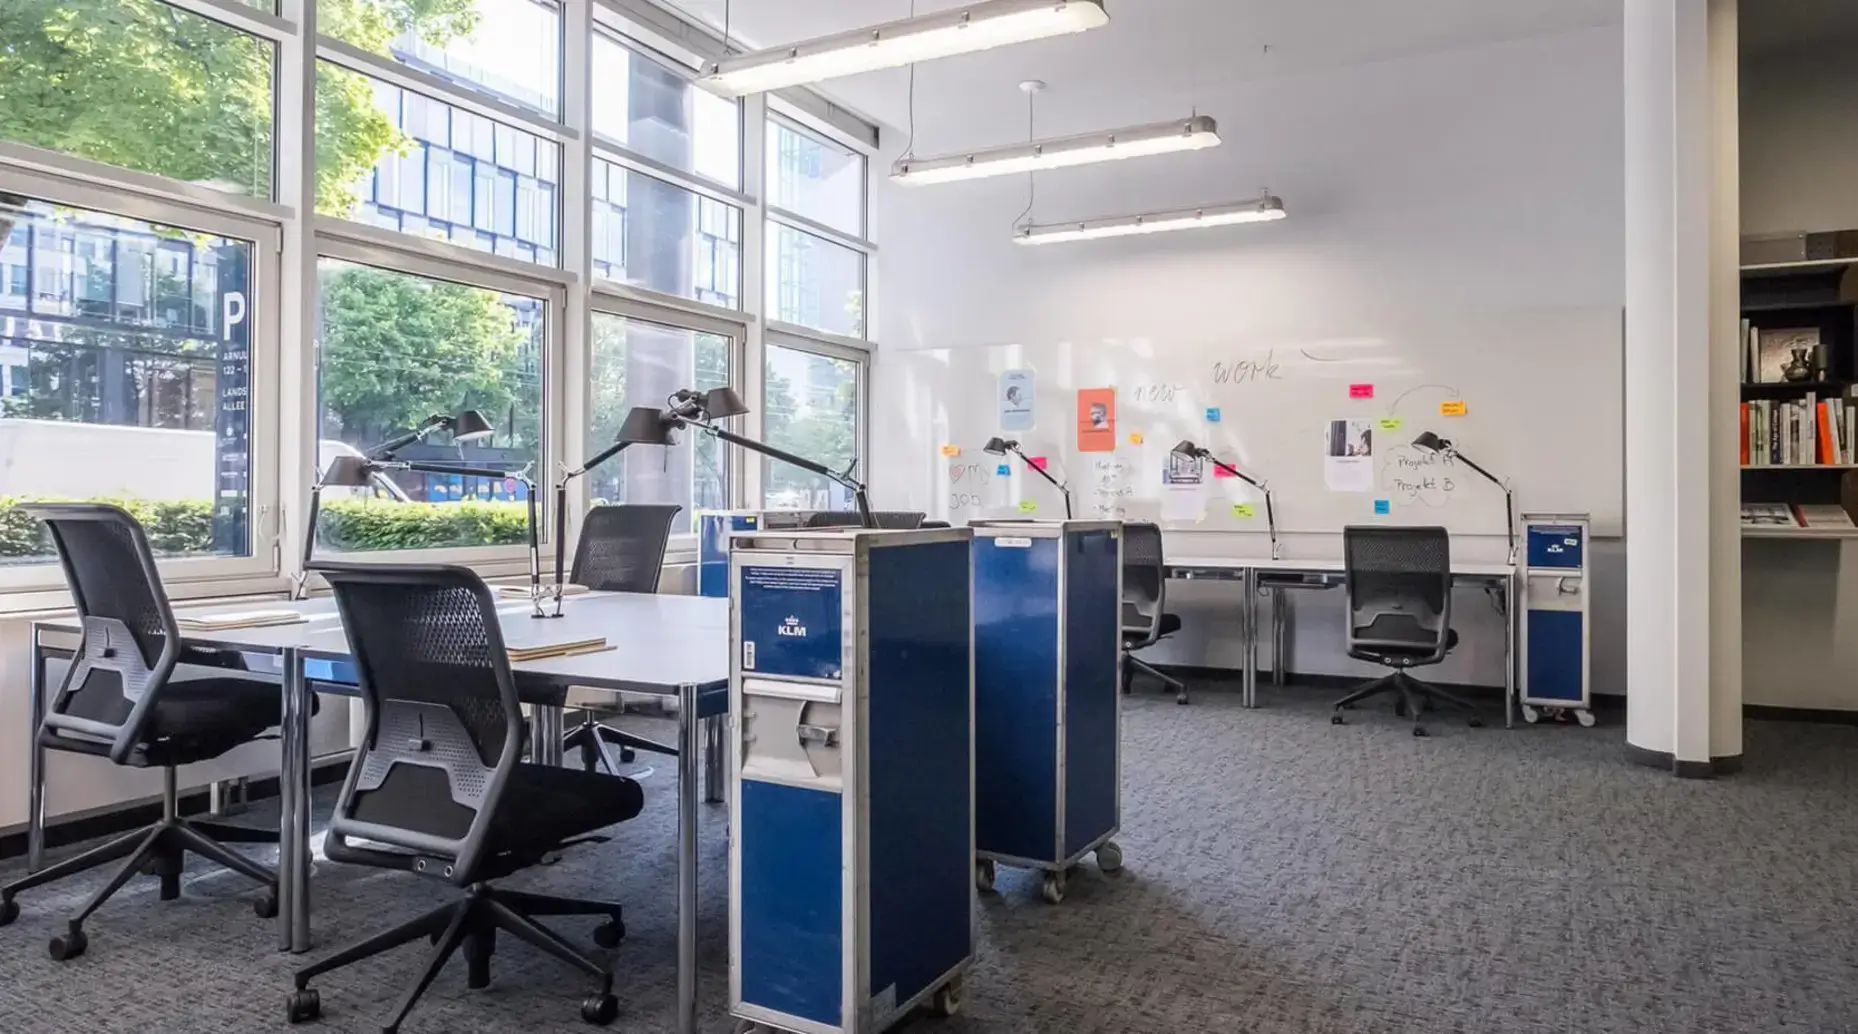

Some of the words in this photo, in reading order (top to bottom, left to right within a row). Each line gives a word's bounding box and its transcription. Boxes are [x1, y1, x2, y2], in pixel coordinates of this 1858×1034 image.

[224, 291, 245, 340] P
[1213, 347, 1284, 384] work
[222, 400, 245, 411] ALLEE
[1442, 477, 1455, 491] B
[778, 625, 806, 636] KLM
